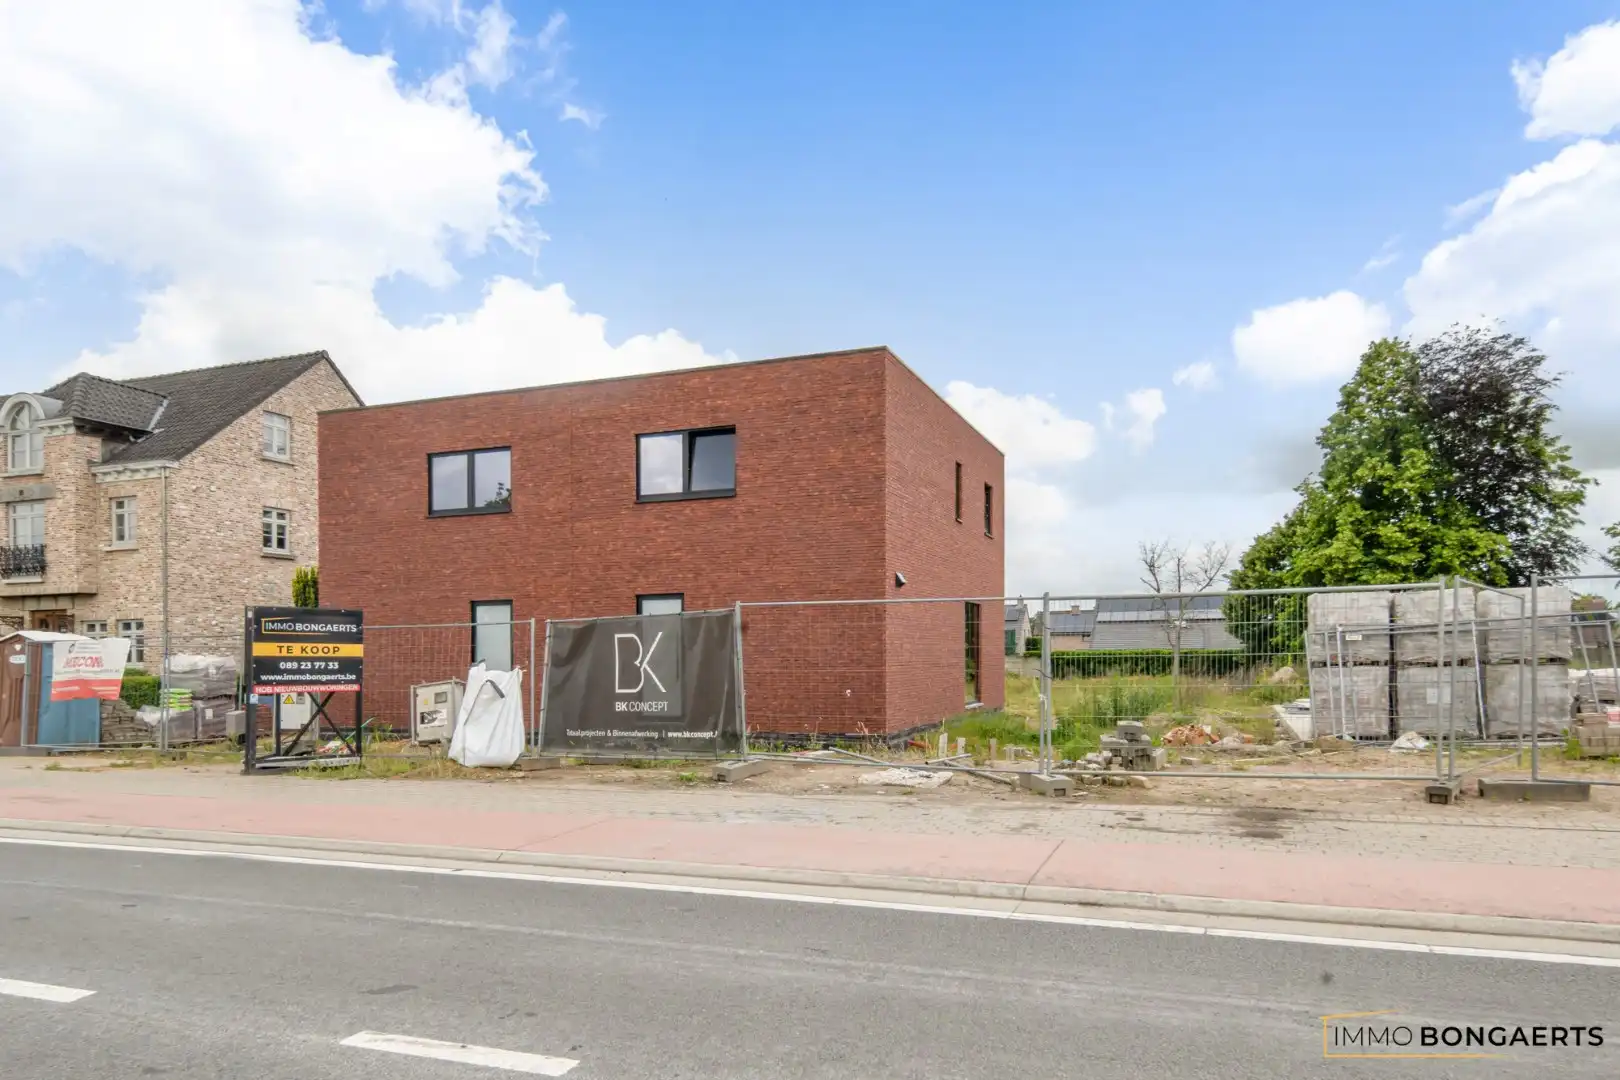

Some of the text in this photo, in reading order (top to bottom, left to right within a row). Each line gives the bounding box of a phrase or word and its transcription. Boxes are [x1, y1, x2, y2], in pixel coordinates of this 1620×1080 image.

[265, 622, 357, 632] IMMO BONGAERTS
[277, 645, 340, 654] TE KOOP
[279, 661, 298, 669] 089
[300, 661, 312, 669] 23
[260, 673, 356, 682] www.immobongaerts.be
[615, 702, 668, 712] BK CONCEPT
